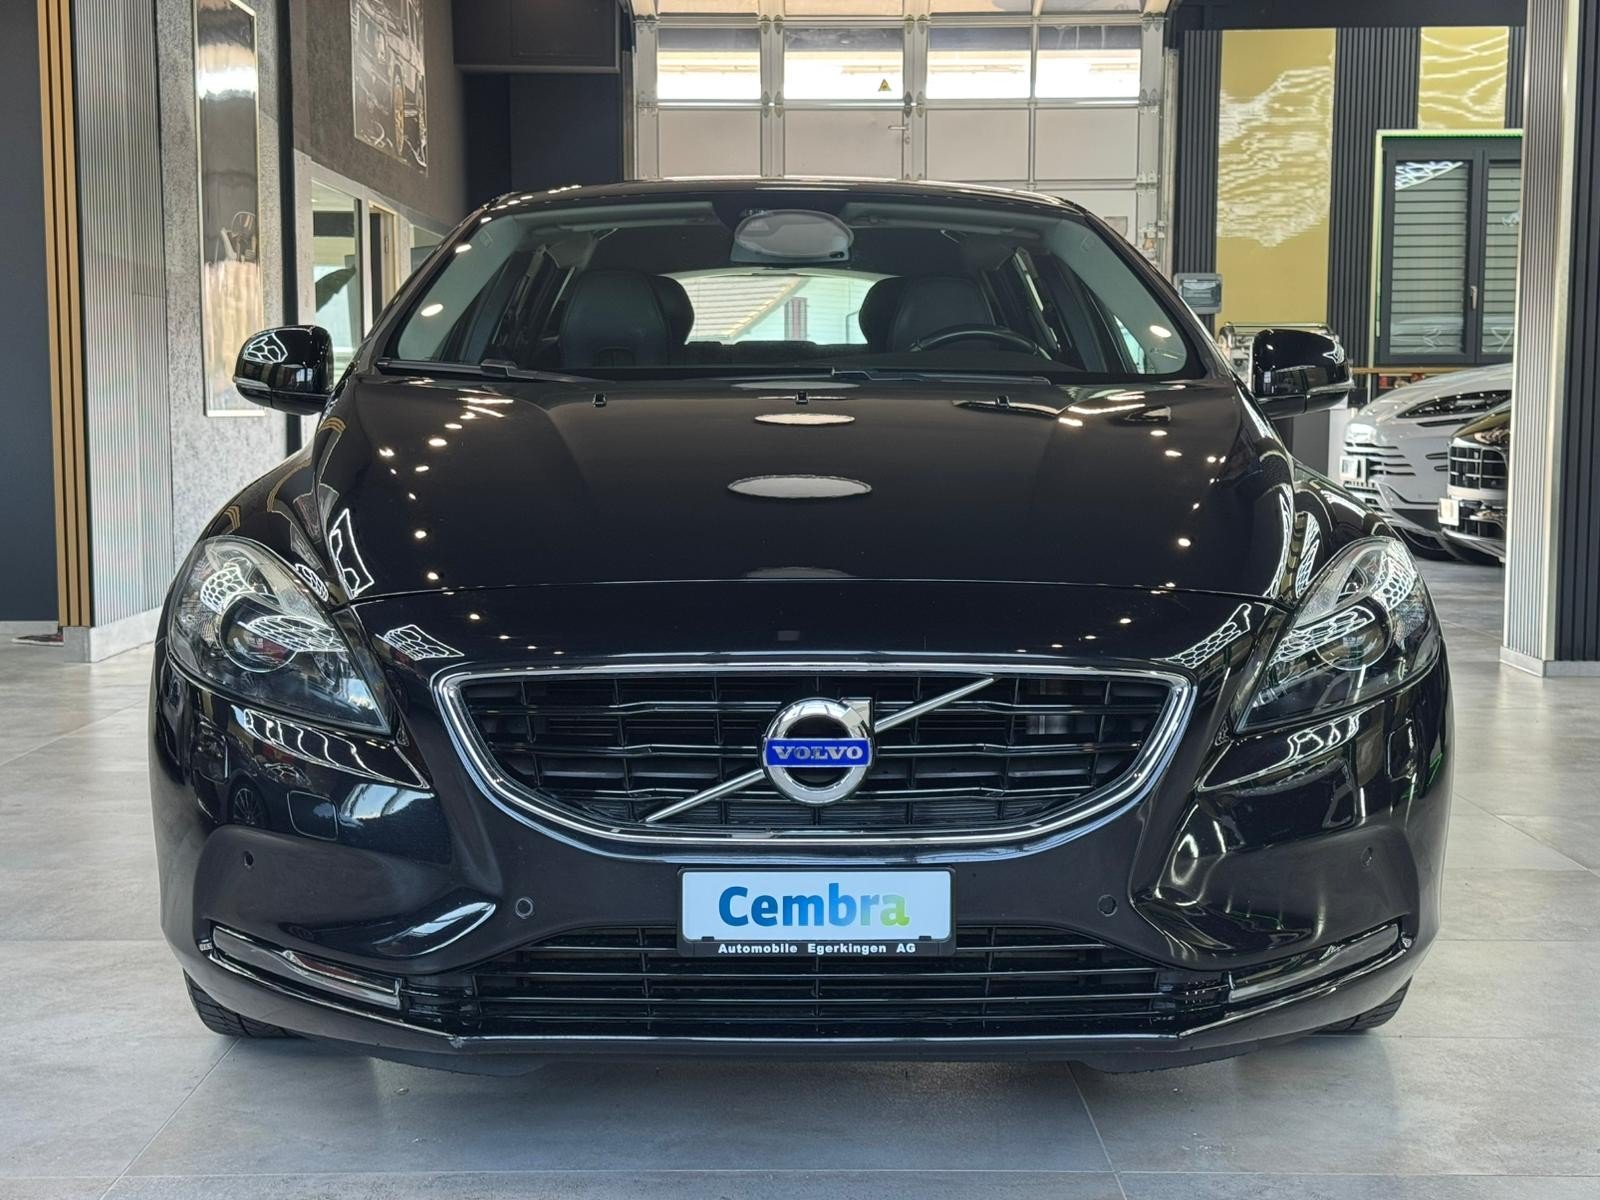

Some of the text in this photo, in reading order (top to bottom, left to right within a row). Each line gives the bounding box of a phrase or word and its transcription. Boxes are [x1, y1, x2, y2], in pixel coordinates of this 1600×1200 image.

[772, 746, 863, 760] VOLVO
[718, 883, 910, 927] Cembra
[718, 943, 916, 955] Automobile Egerkingen AG
